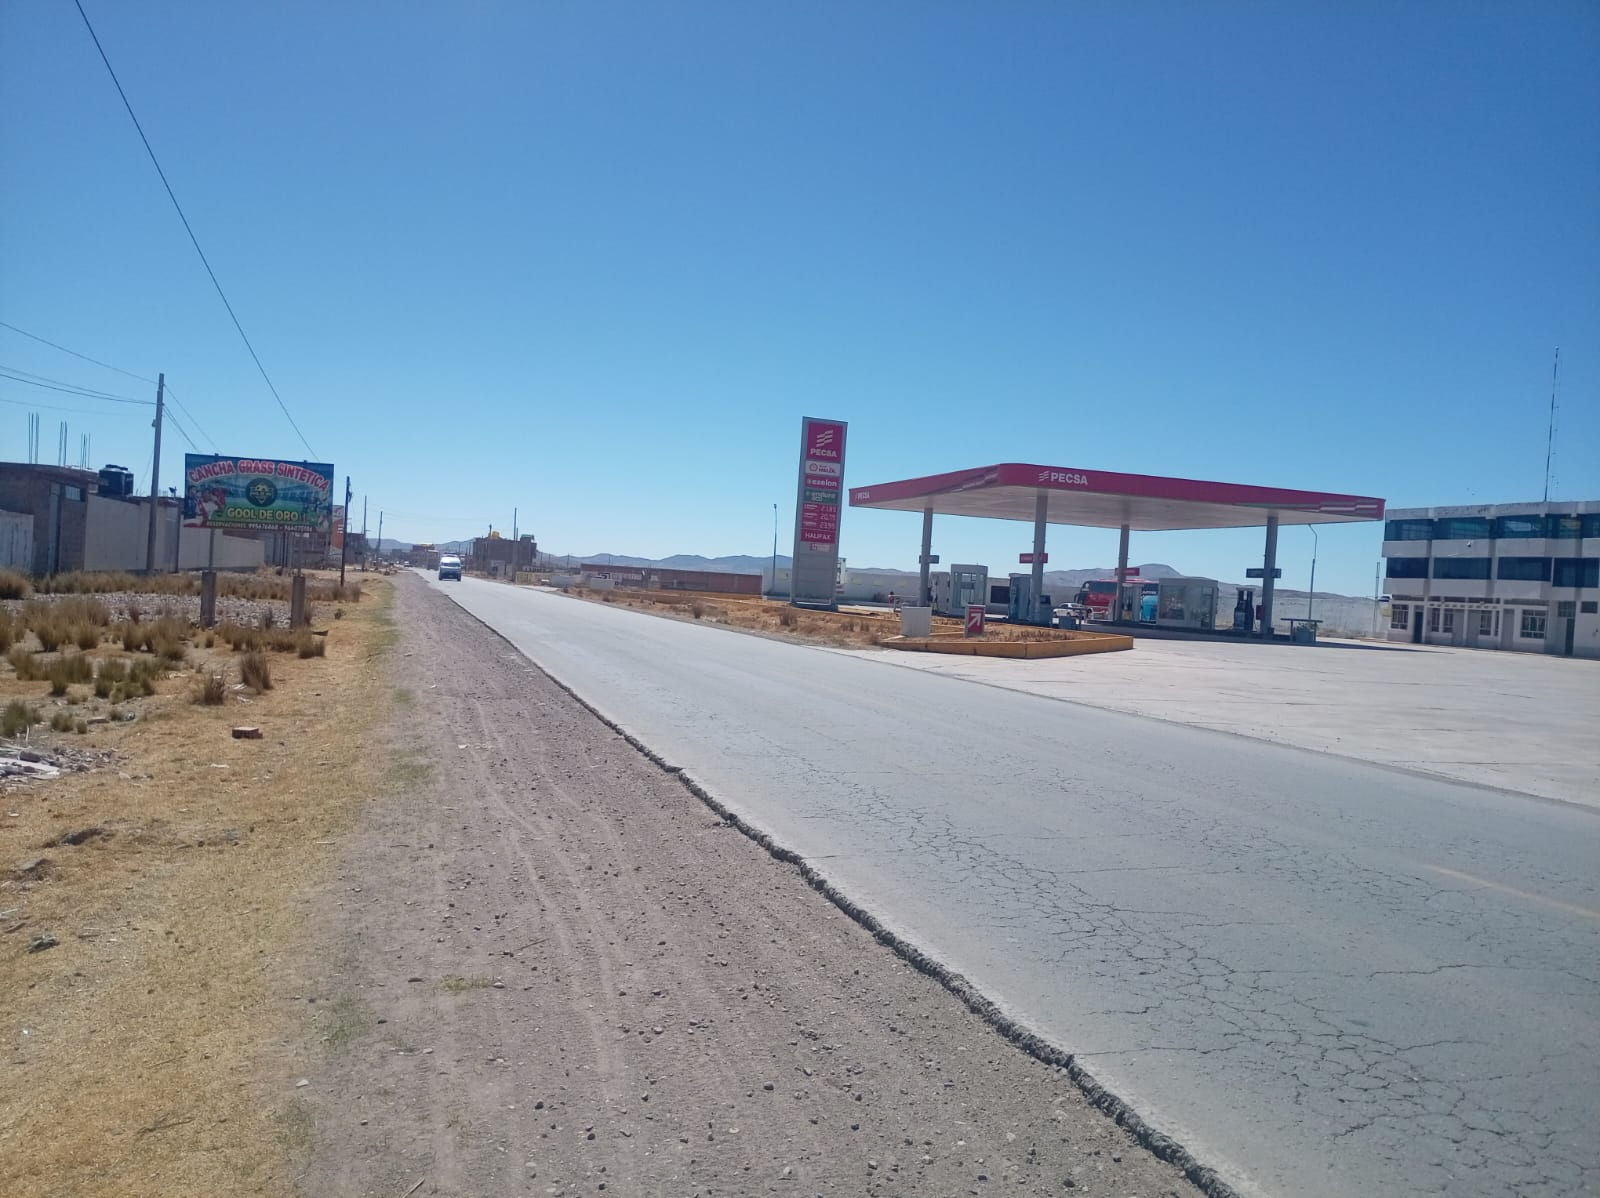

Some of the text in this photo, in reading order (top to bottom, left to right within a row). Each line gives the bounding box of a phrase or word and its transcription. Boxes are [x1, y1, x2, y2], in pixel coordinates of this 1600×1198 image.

[811, 448, 837, 457] PECSA
[189, 459, 330, 491] CANCHA GRASS SINTETICA
[1051, 472, 1088, 485] PECSA
[227, 507, 298, 520] GOOL DE ORO
[805, 532, 832, 540] HALIFAX
